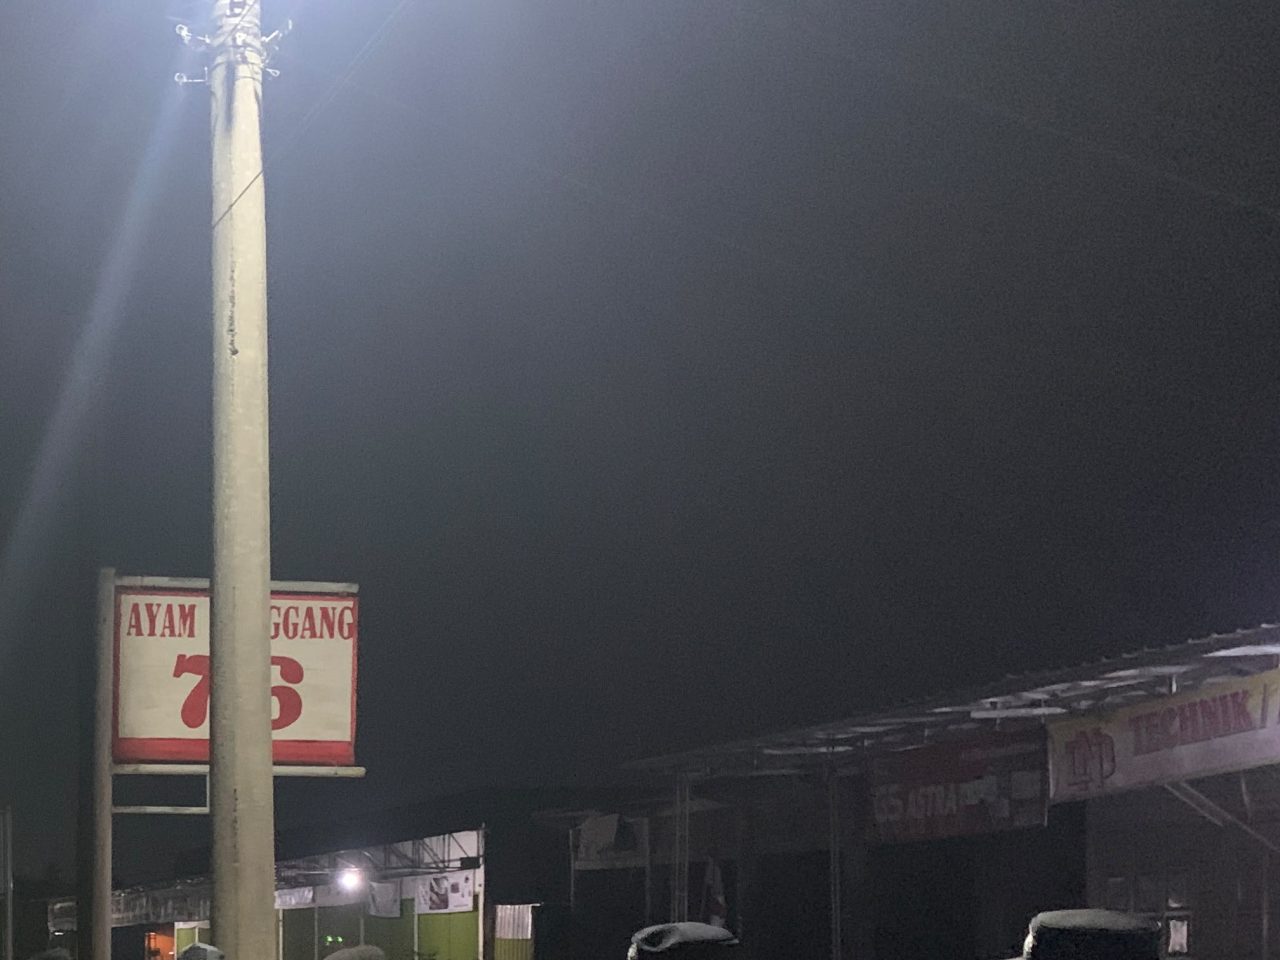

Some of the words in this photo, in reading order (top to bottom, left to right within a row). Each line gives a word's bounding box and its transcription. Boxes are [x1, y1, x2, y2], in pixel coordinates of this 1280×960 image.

[127, 603, 196, 638] AYAM
[270, 606, 354, 640] GGANG
[1128, 690, 1253, 757] TECHNIK
